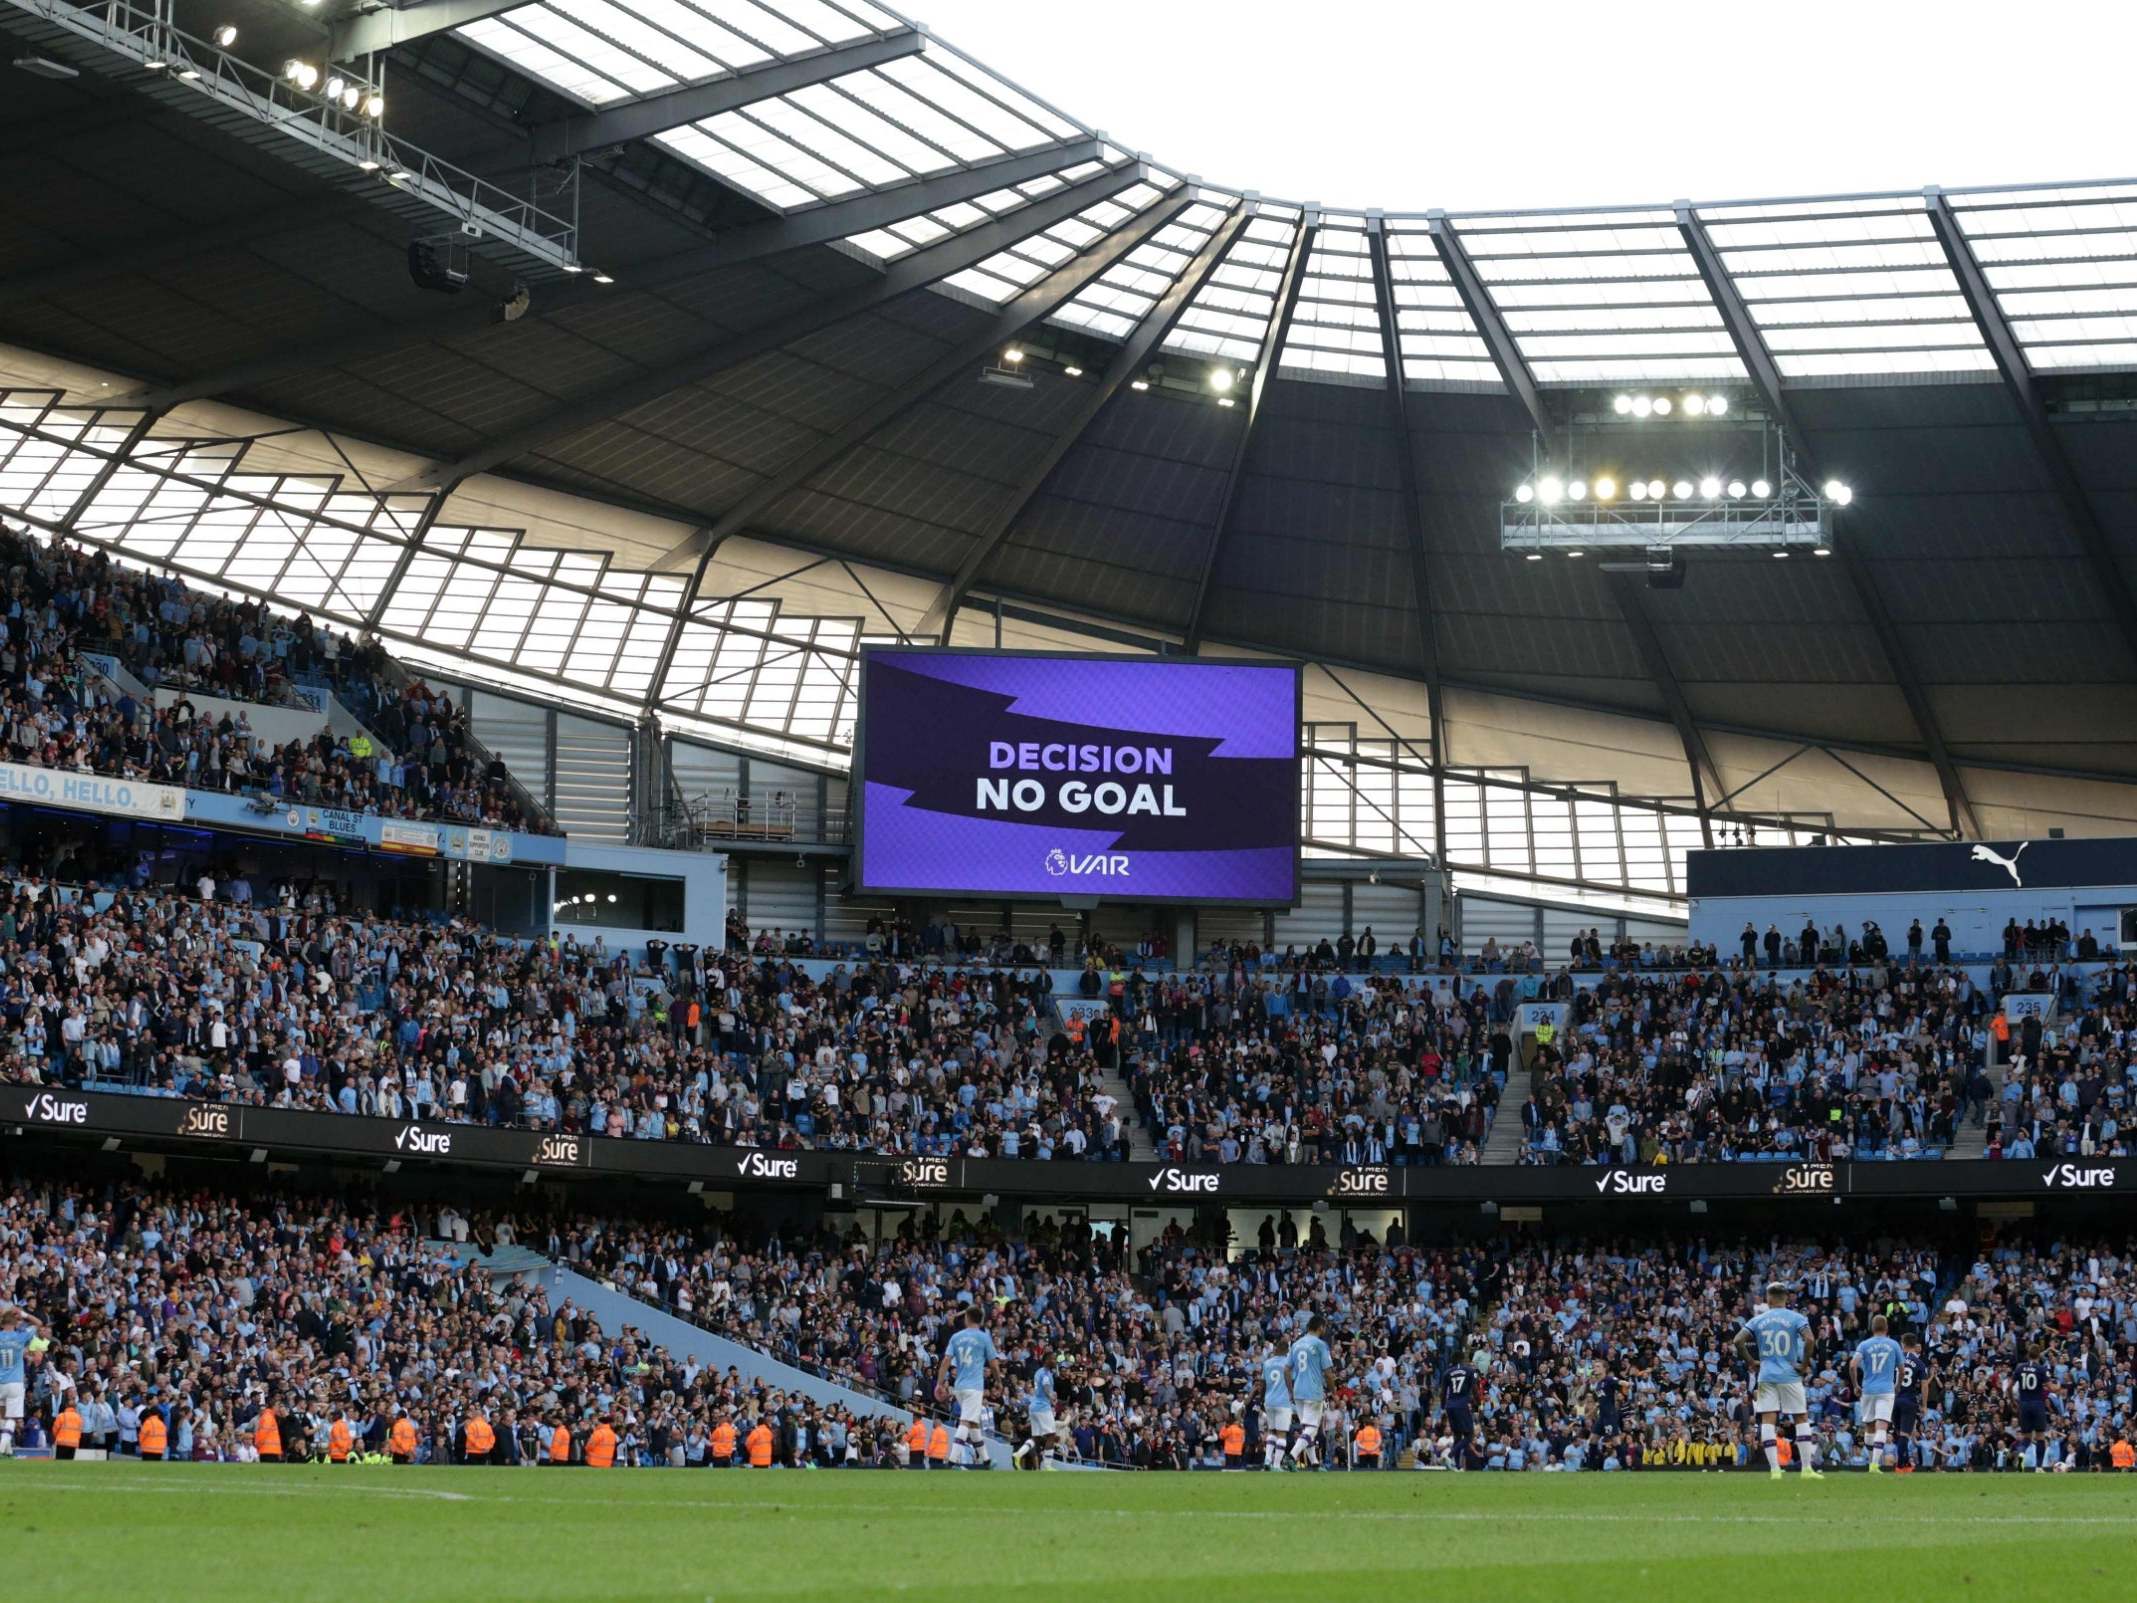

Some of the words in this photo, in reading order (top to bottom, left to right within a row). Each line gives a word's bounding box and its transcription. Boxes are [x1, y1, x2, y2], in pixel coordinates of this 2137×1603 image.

[989, 741, 1172, 775] DECISION
[64, 778, 137, 808] HELLO.
[976, 778, 1046, 812] NO
[1058, 780, 1187, 817] GOAL
[322, 809, 350, 822] CANAL
[353, 815, 364, 824] ST
[329, 820, 357, 833] BLUES
[1070, 854, 1130, 876] VAR
[40, 1094, 87, 1124] Sure
[187, 1106, 229, 1132] Sure
[409, 1126, 450, 1153] Sure
[541, 1137, 578, 1161] Sure
[752, 1153, 797, 1178] Sure
[903, 1160, 947, 1183] Sure
[2060, 1163, 2115, 1187] Sure
[1166, 1168, 1219, 1192] Sure
[1339, 1171, 1388, 1192] Sure
[1613, 1170, 1666, 1193] Sure
[1785, 1168, 1834, 1190] Sure
[1760, 1329, 1791, 1357] 30
[958, 1346, 973, 1367] 14
[1297, 1350, 1308, 1373] 8
[1871, 1351, 1889, 1375] 17
[1270, 1369, 1281, 1388] 9
[1450, 1375, 1466, 1394] 17
[2020, 1372, 2038, 1390] 10
